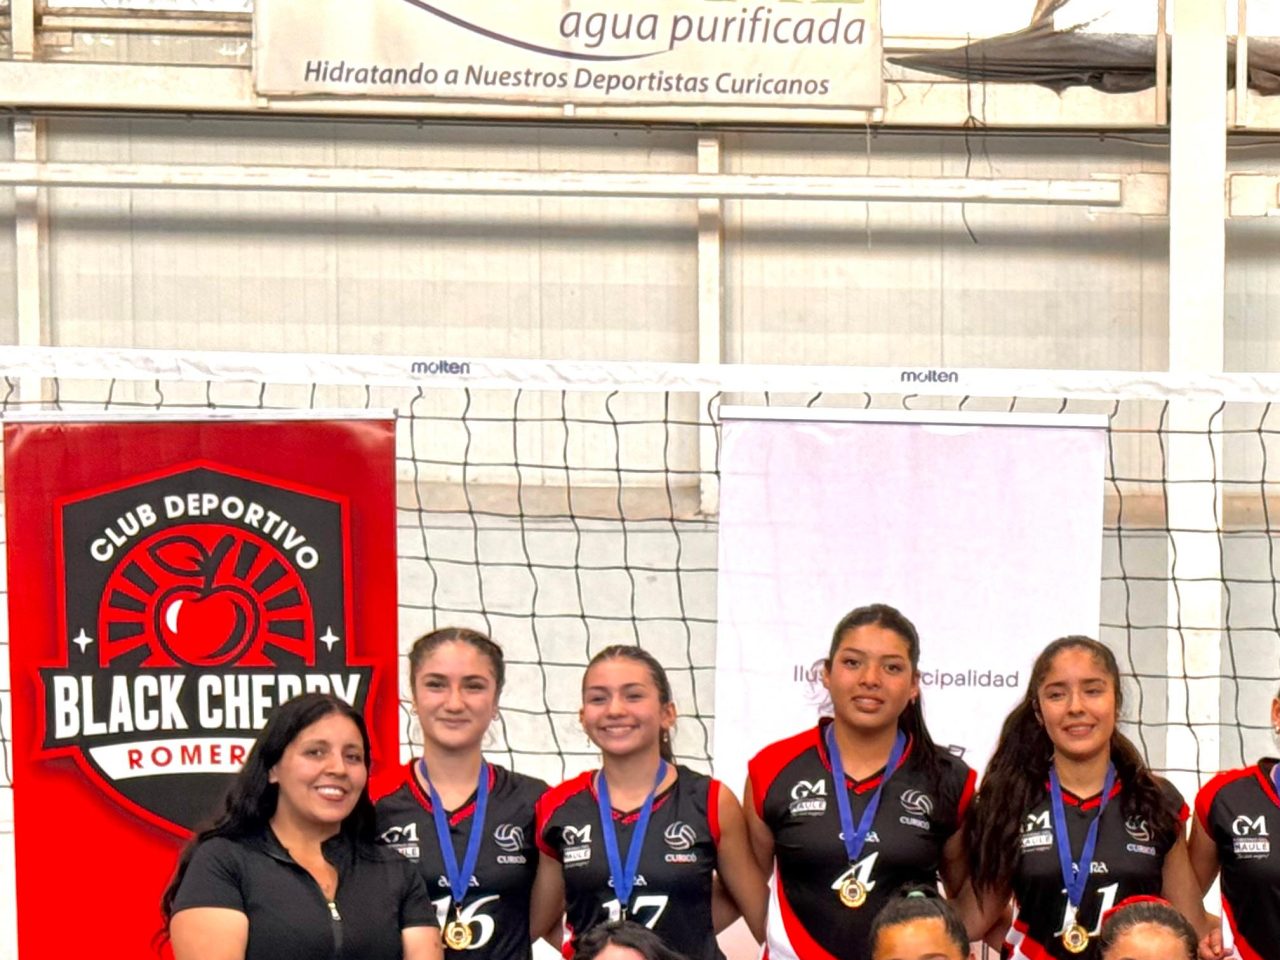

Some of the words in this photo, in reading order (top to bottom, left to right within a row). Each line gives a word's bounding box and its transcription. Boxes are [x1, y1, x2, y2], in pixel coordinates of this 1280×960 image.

[559, 10, 659, 48] agua
[668, 6, 866, 51] purificada
[303, 60, 438, 85] Hidratando
[444, 68, 459, 85] a
[465, 64, 568, 89] Nuestros
[574, 67, 709, 95] Deportistas
[715, 72, 829, 95] Curicanos
[411, 360, 471, 375] molten
[900, 369, 959, 384] molten
[90, 503, 158, 562] CLUB
[163, 493, 319, 570] DEPORTIVO
[53, 674, 189, 740] BLACK
[128, 744, 247, 770] ROMER
[1233, 841, 1269, 852] MAULE
[431, 894, 500, 949] 16
